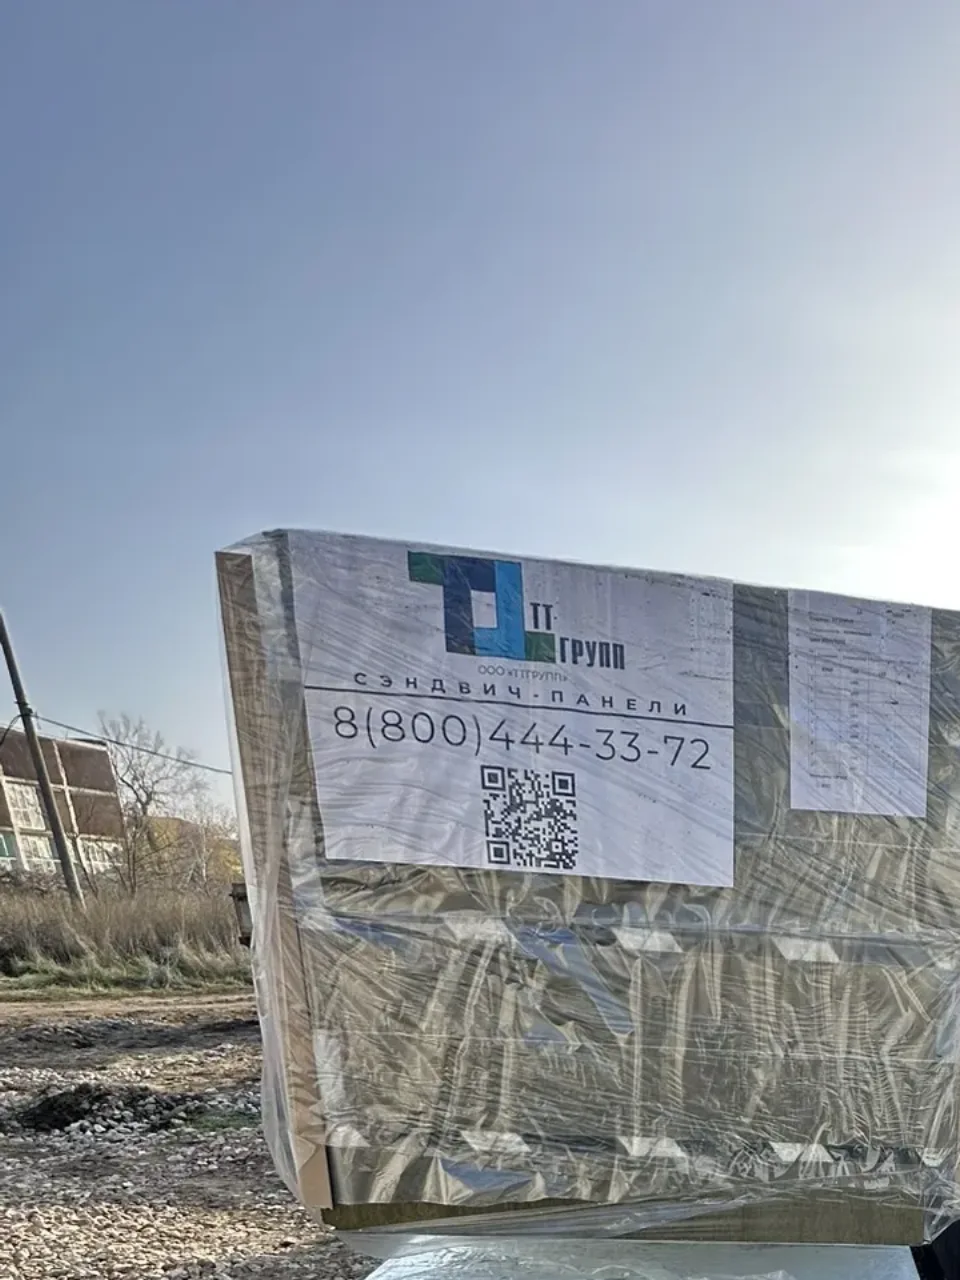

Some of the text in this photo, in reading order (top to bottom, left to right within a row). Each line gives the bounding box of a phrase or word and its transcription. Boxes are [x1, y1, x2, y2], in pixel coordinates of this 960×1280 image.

[529, 602, 554, 631] ТТ
[559, 636, 625, 670] ГРУПП
[353, 671, 687, 716] СЭНДВИЧ-ПАНЕЛИ
[333, 705, 712, 770] 8(800)444-33-72
